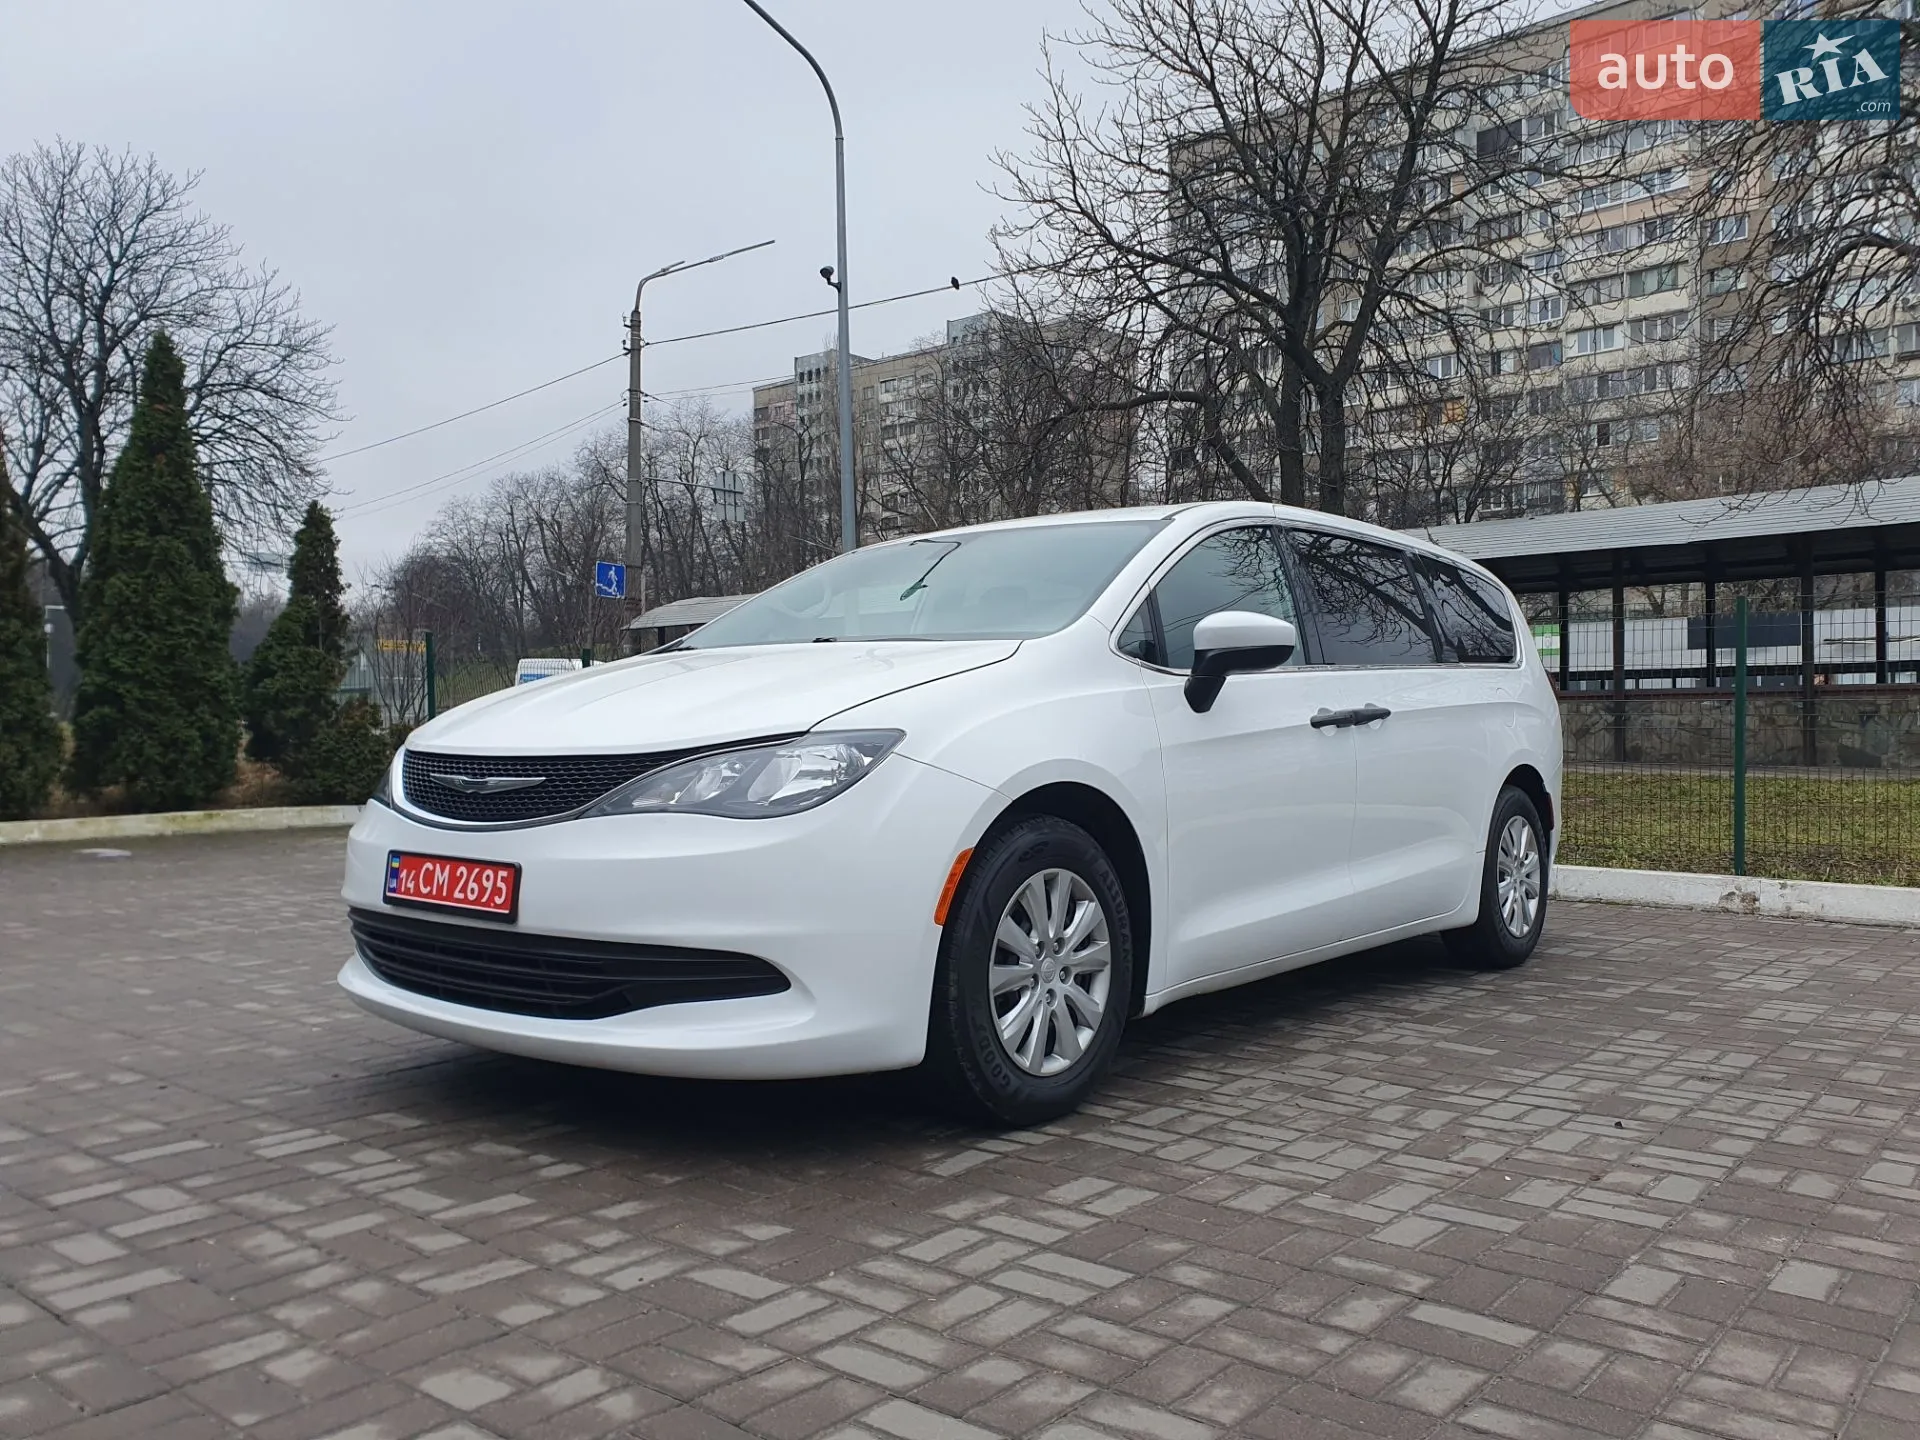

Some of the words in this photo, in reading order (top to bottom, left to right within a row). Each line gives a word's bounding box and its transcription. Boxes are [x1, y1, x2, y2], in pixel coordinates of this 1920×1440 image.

[400, 869, 416, 894] 14
[419, 862, 450, 897] CM
[453, 866, 508, 905] 2695
